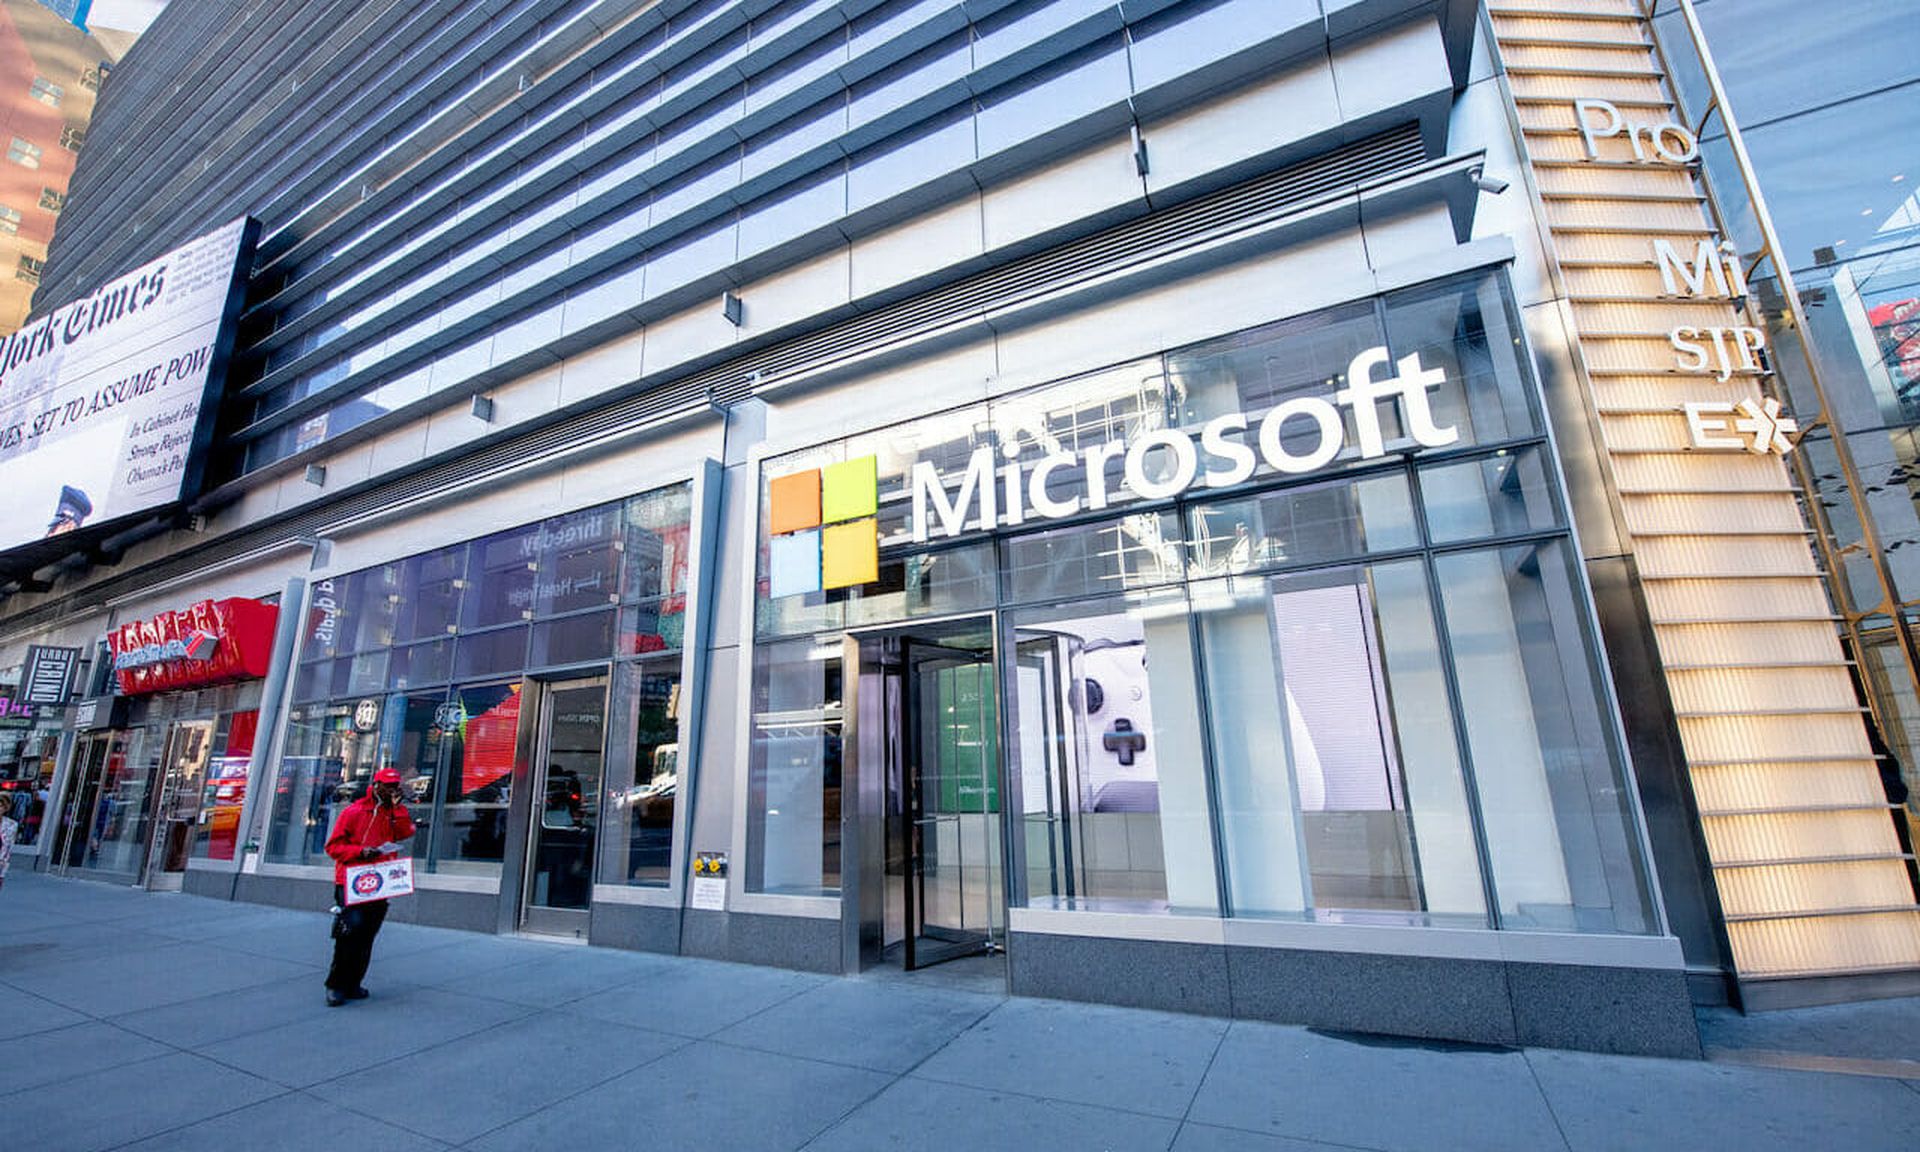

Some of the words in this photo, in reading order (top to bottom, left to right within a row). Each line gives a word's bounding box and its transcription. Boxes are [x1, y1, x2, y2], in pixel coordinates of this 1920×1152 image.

[1575, 99, 1700, 163] Pro
[1653, 239, 1747, 298] Mi
[1670, 325, 1767, 383] SJP
[28, 406, 61, 439] SET
[61, 396, 85, 426] TO
[85, 364, 162, 417] ASSUME
[911, 345, 1459, 543] Microsoft
